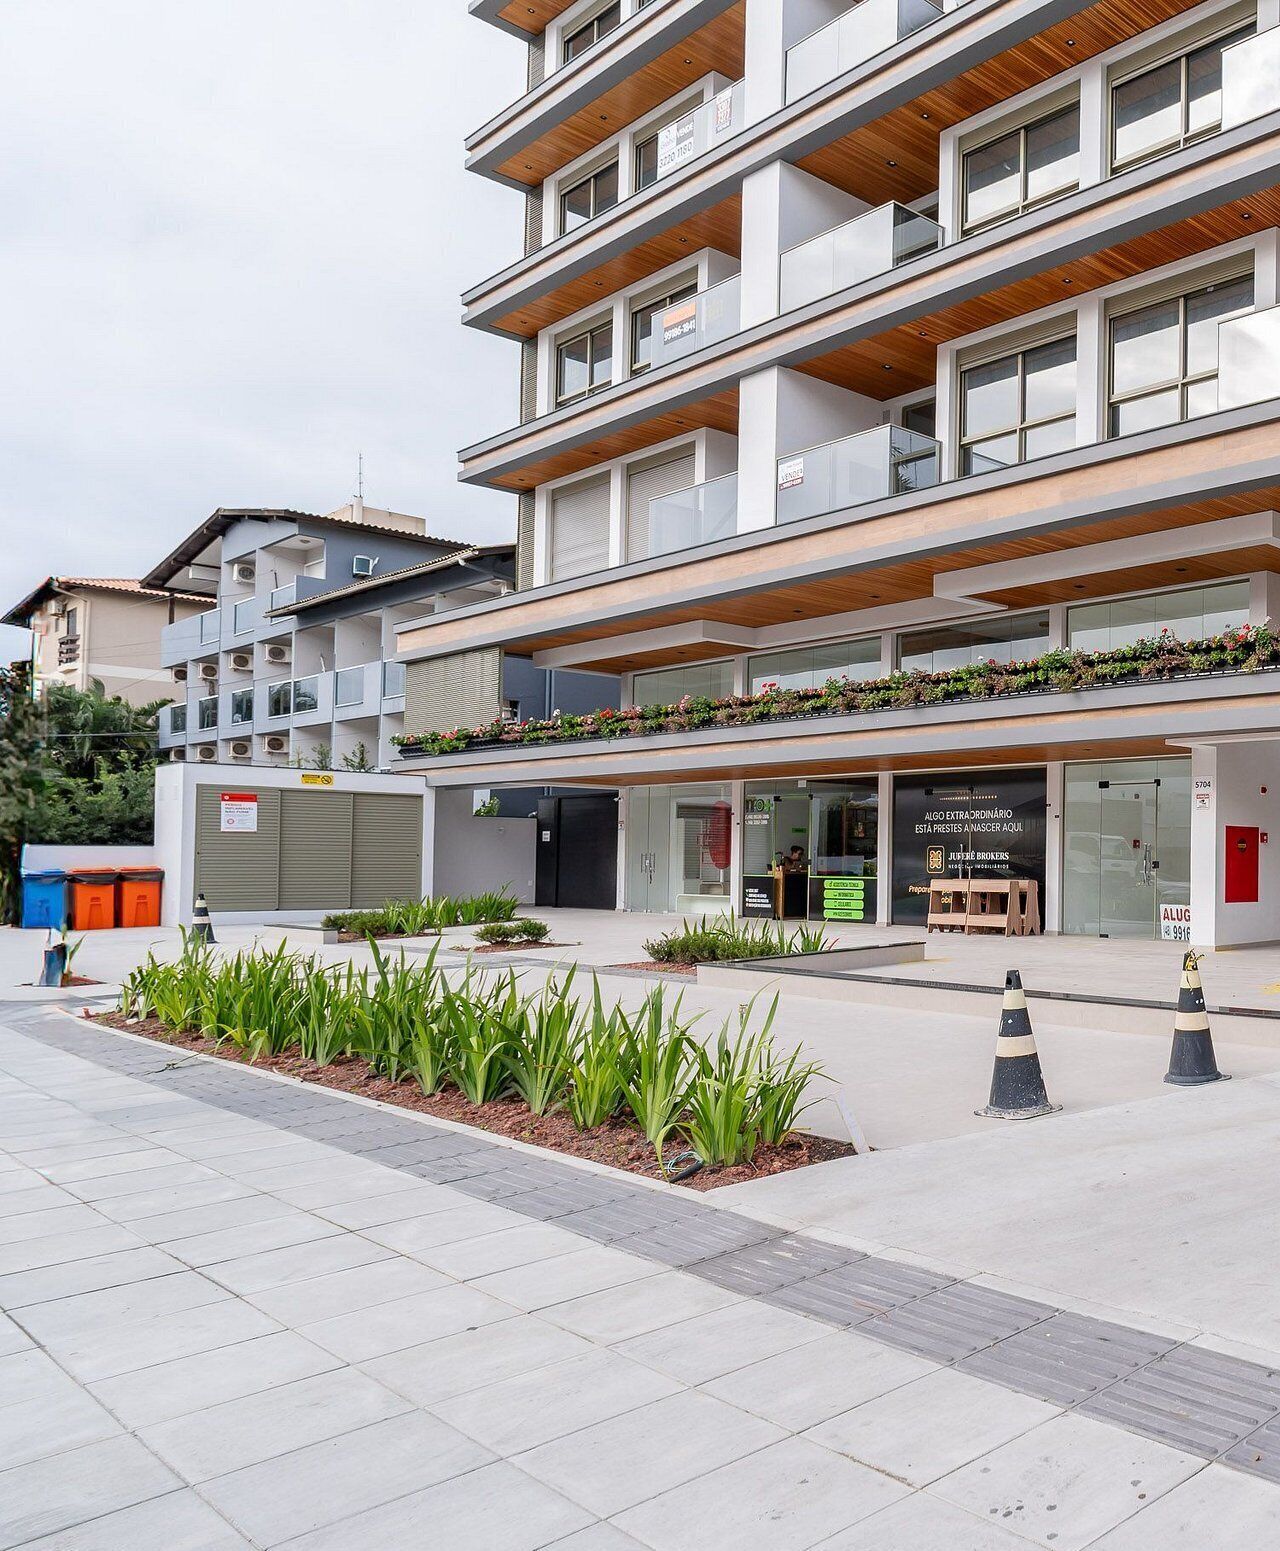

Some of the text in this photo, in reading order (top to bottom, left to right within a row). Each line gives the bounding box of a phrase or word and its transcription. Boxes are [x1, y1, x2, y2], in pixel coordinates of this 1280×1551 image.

[925, 807, 1013, 820] ALGO EXTRAORDINÁRIO
[915, 822, 932, 833] ESTÁ
[933, 824, 962, 833] PRESTES
[963, 823, 970, 832] A
[971, 823, 1000, 832] NASCER
[976, 852, 1010, 860] BROKERS
